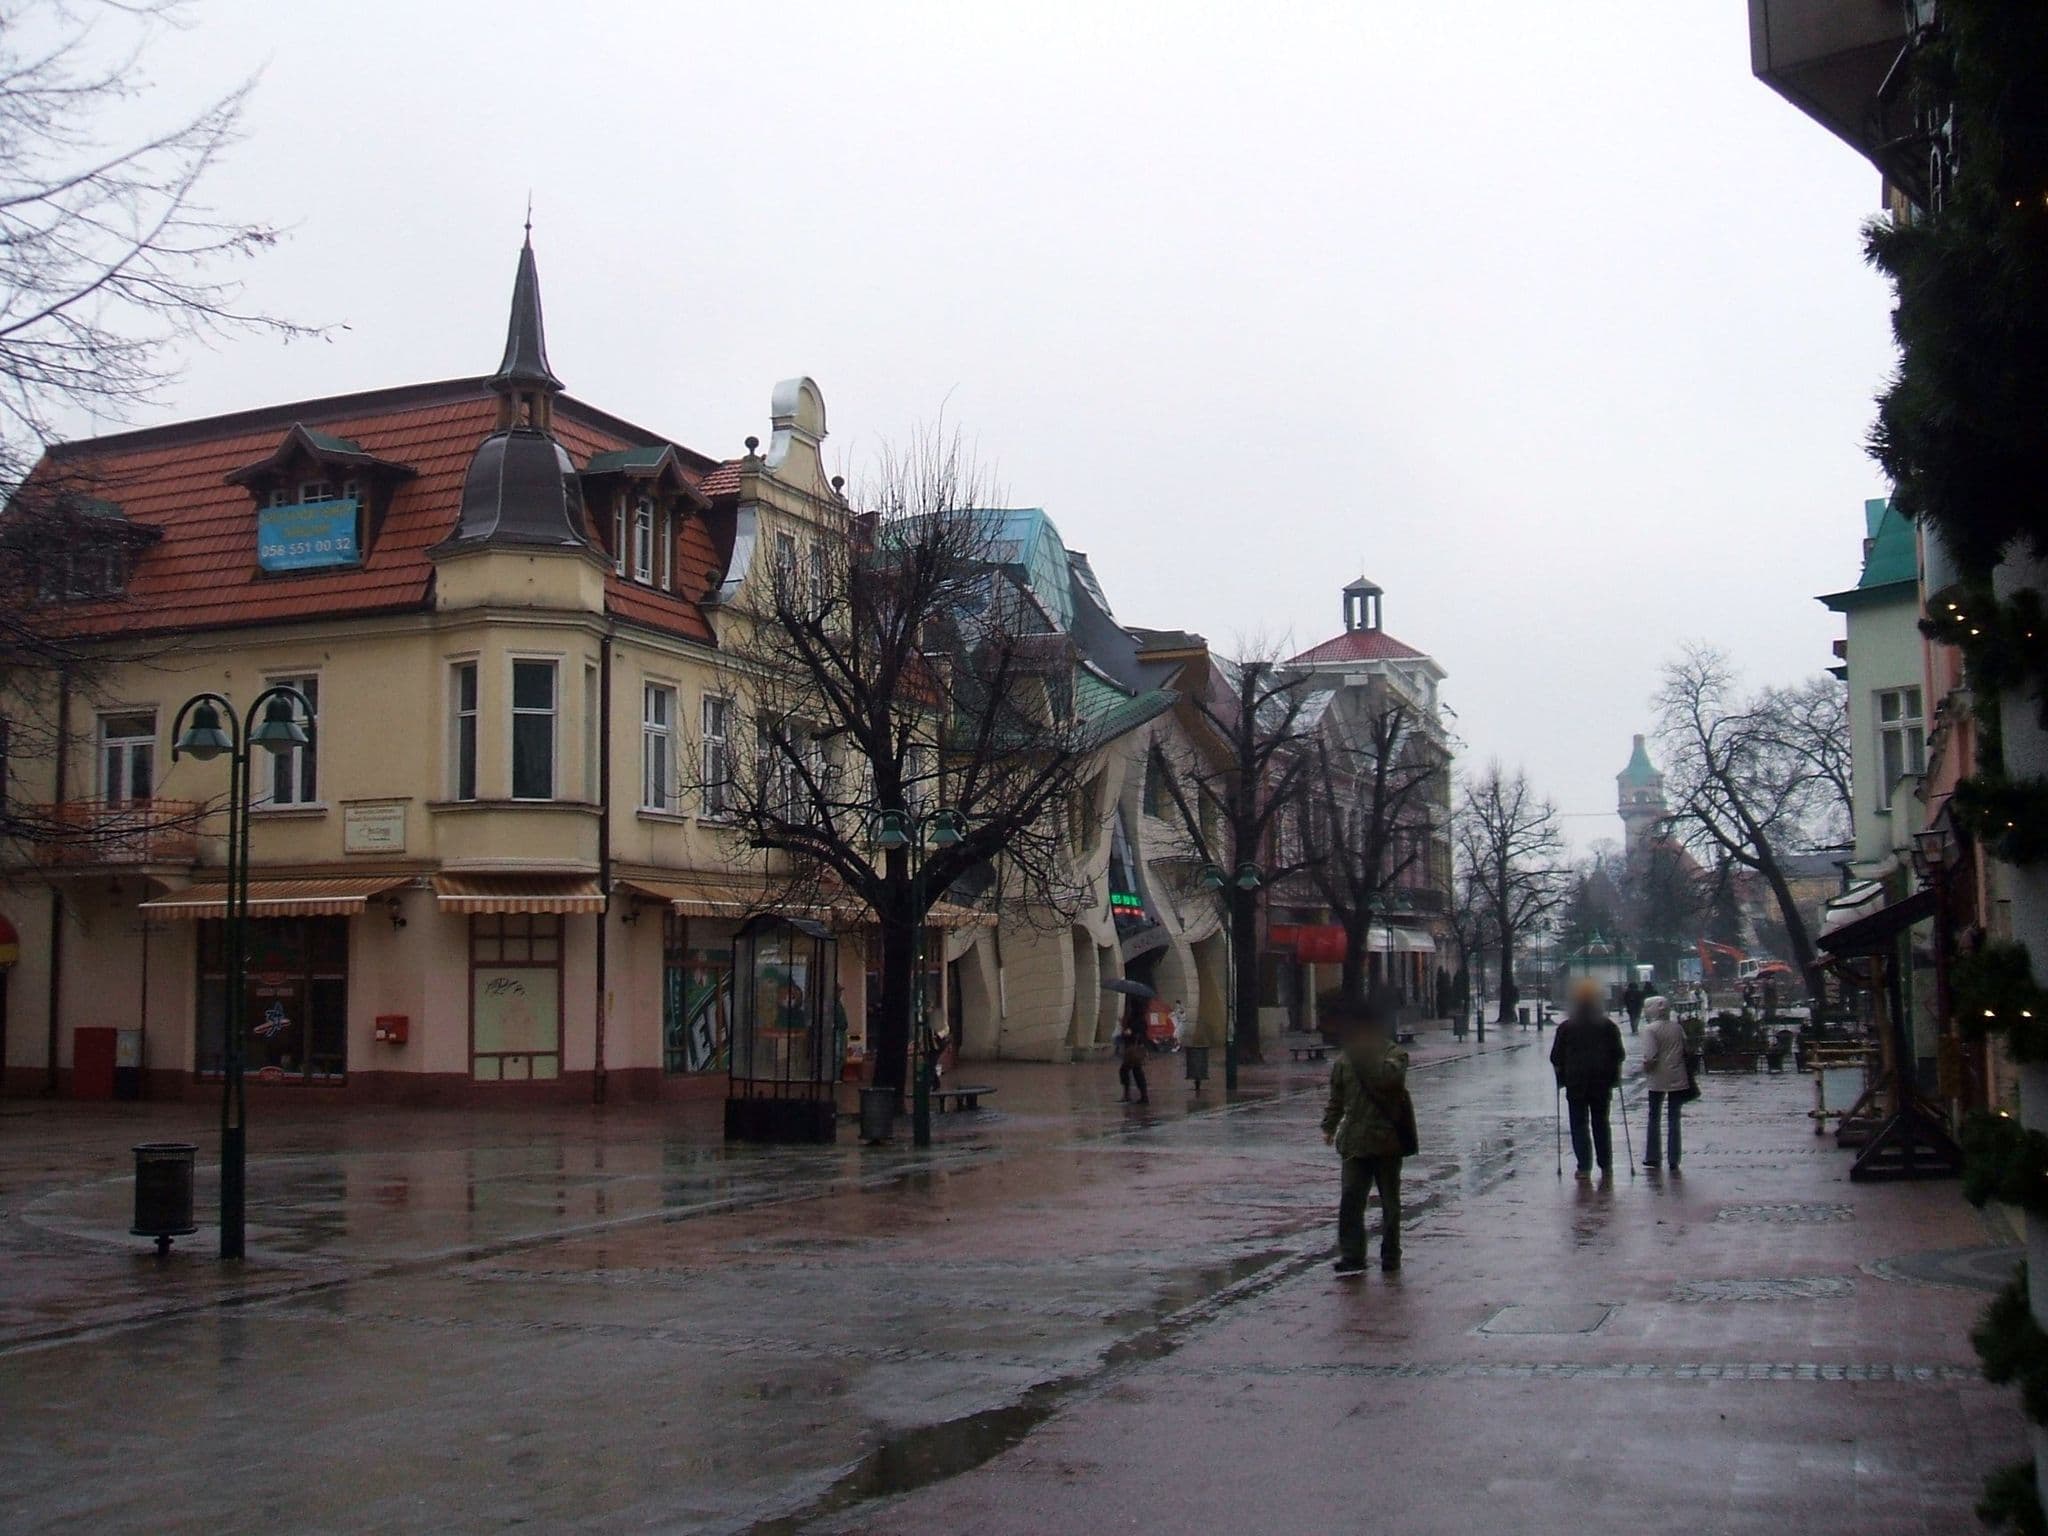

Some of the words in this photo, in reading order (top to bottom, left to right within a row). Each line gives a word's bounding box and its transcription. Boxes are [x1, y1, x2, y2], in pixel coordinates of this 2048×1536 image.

[288, 541, 311, 555] 551
[315, 539, 332, 552] 00
[335, 537, 351, 550] 32
